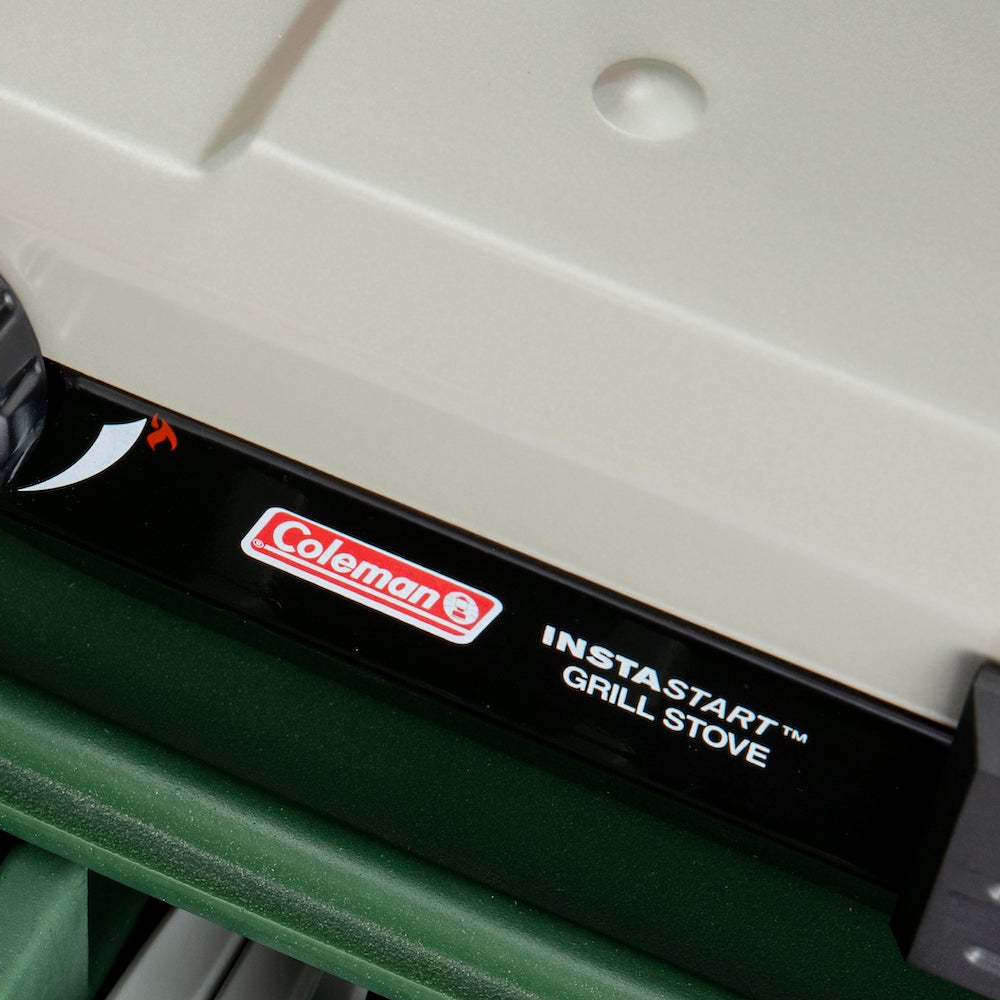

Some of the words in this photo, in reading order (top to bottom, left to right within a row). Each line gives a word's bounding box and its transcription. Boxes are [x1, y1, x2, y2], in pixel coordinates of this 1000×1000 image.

[272, 520, 440, 610] Coleman
[563, 665, 655, 721] GRILL
[662, 707, 770, 768] STOVE
